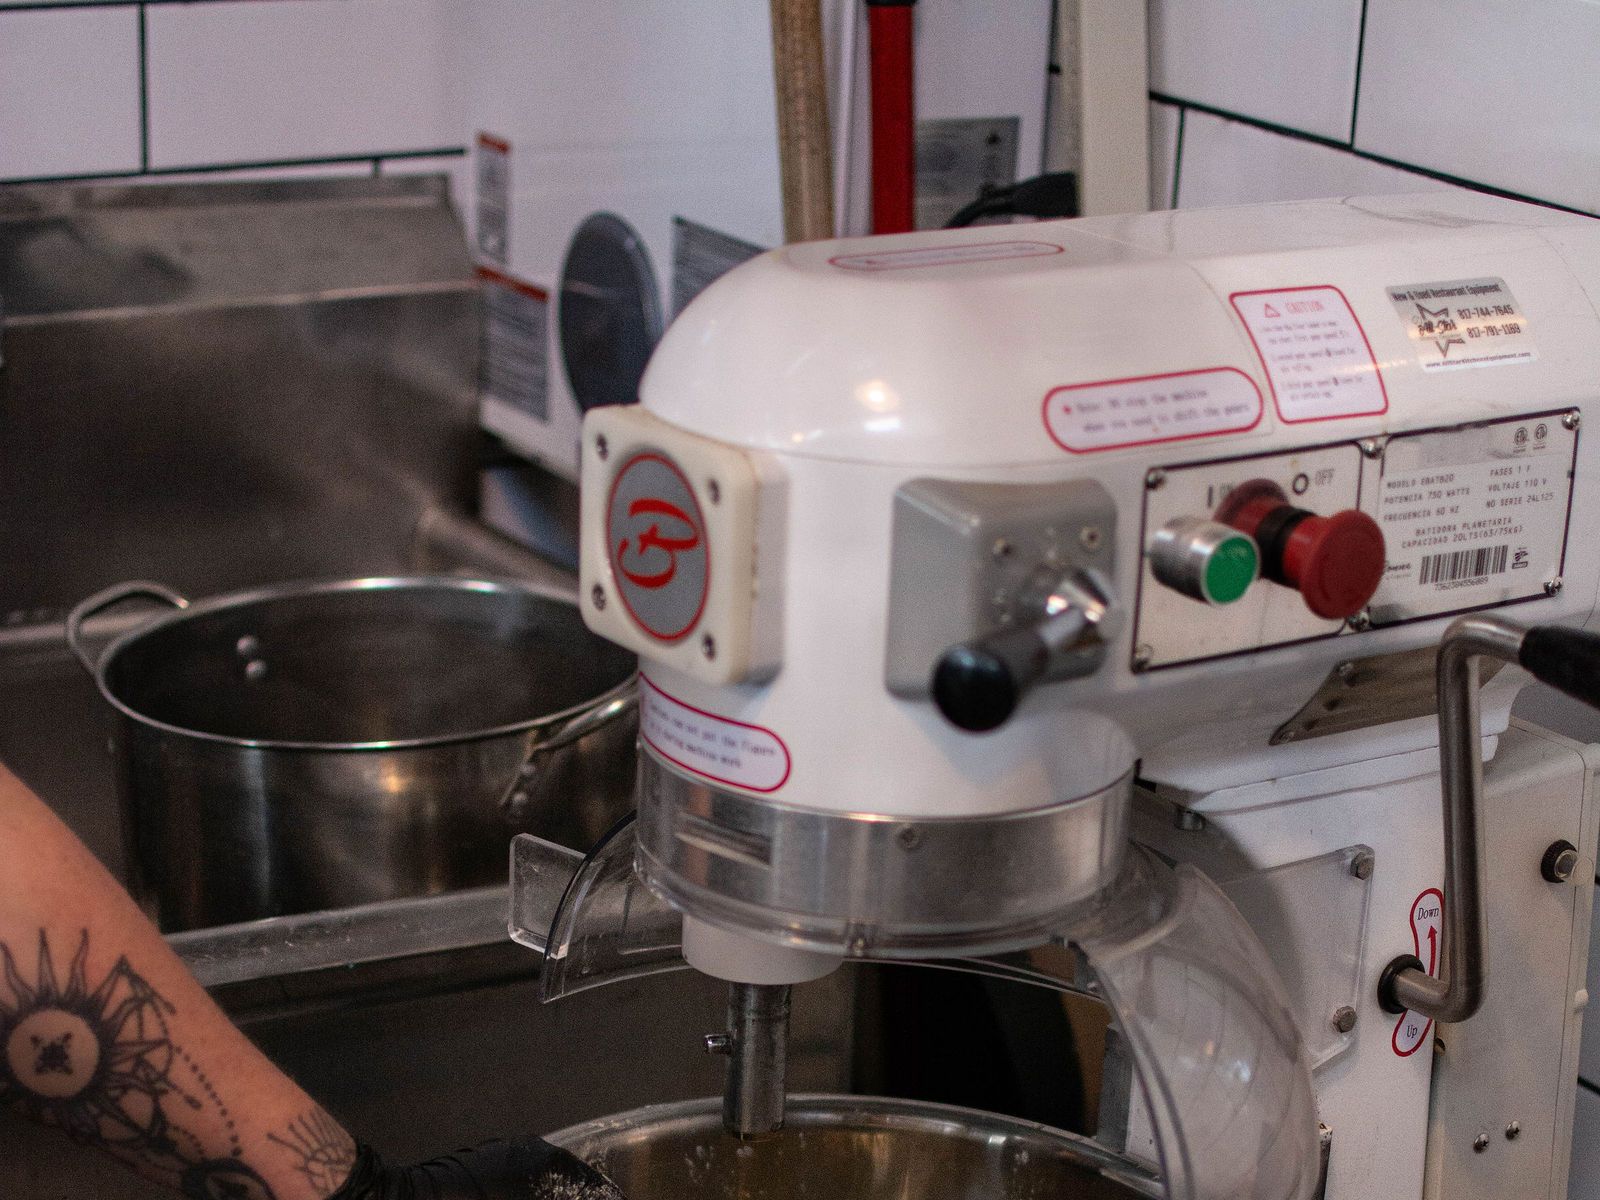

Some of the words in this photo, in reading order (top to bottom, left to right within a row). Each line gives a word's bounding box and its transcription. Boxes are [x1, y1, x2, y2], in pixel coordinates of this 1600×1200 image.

[1429, 286, 1466, 299] Restaurant
[1465, 283, 1502, 297] Equipment
[1457, 305, 1514, 320] 817-744-7645
[1489, 466, 1513, 477] FASES
[1386, 479, 1416, 489] MODELO
[1488, 480, 1521, 492] VOLTAJE
[1524, 478, 1539, 488] 110
[1384, 493, 1423, 504] POTENCIA
[1500, 496, 1523, 507] SERIE
[1383, 509, 1431, 521] FRECUENCIA
[1415, 523, 1457, 537] BATIDORA
[1461, 516, 1512, 531] PLANETARIA
[1401, 535, 1449, 549] CAPACIDAD
[1417, 907, 1440, 921] Down
[1406, 1024, 1418, 1039] Up
